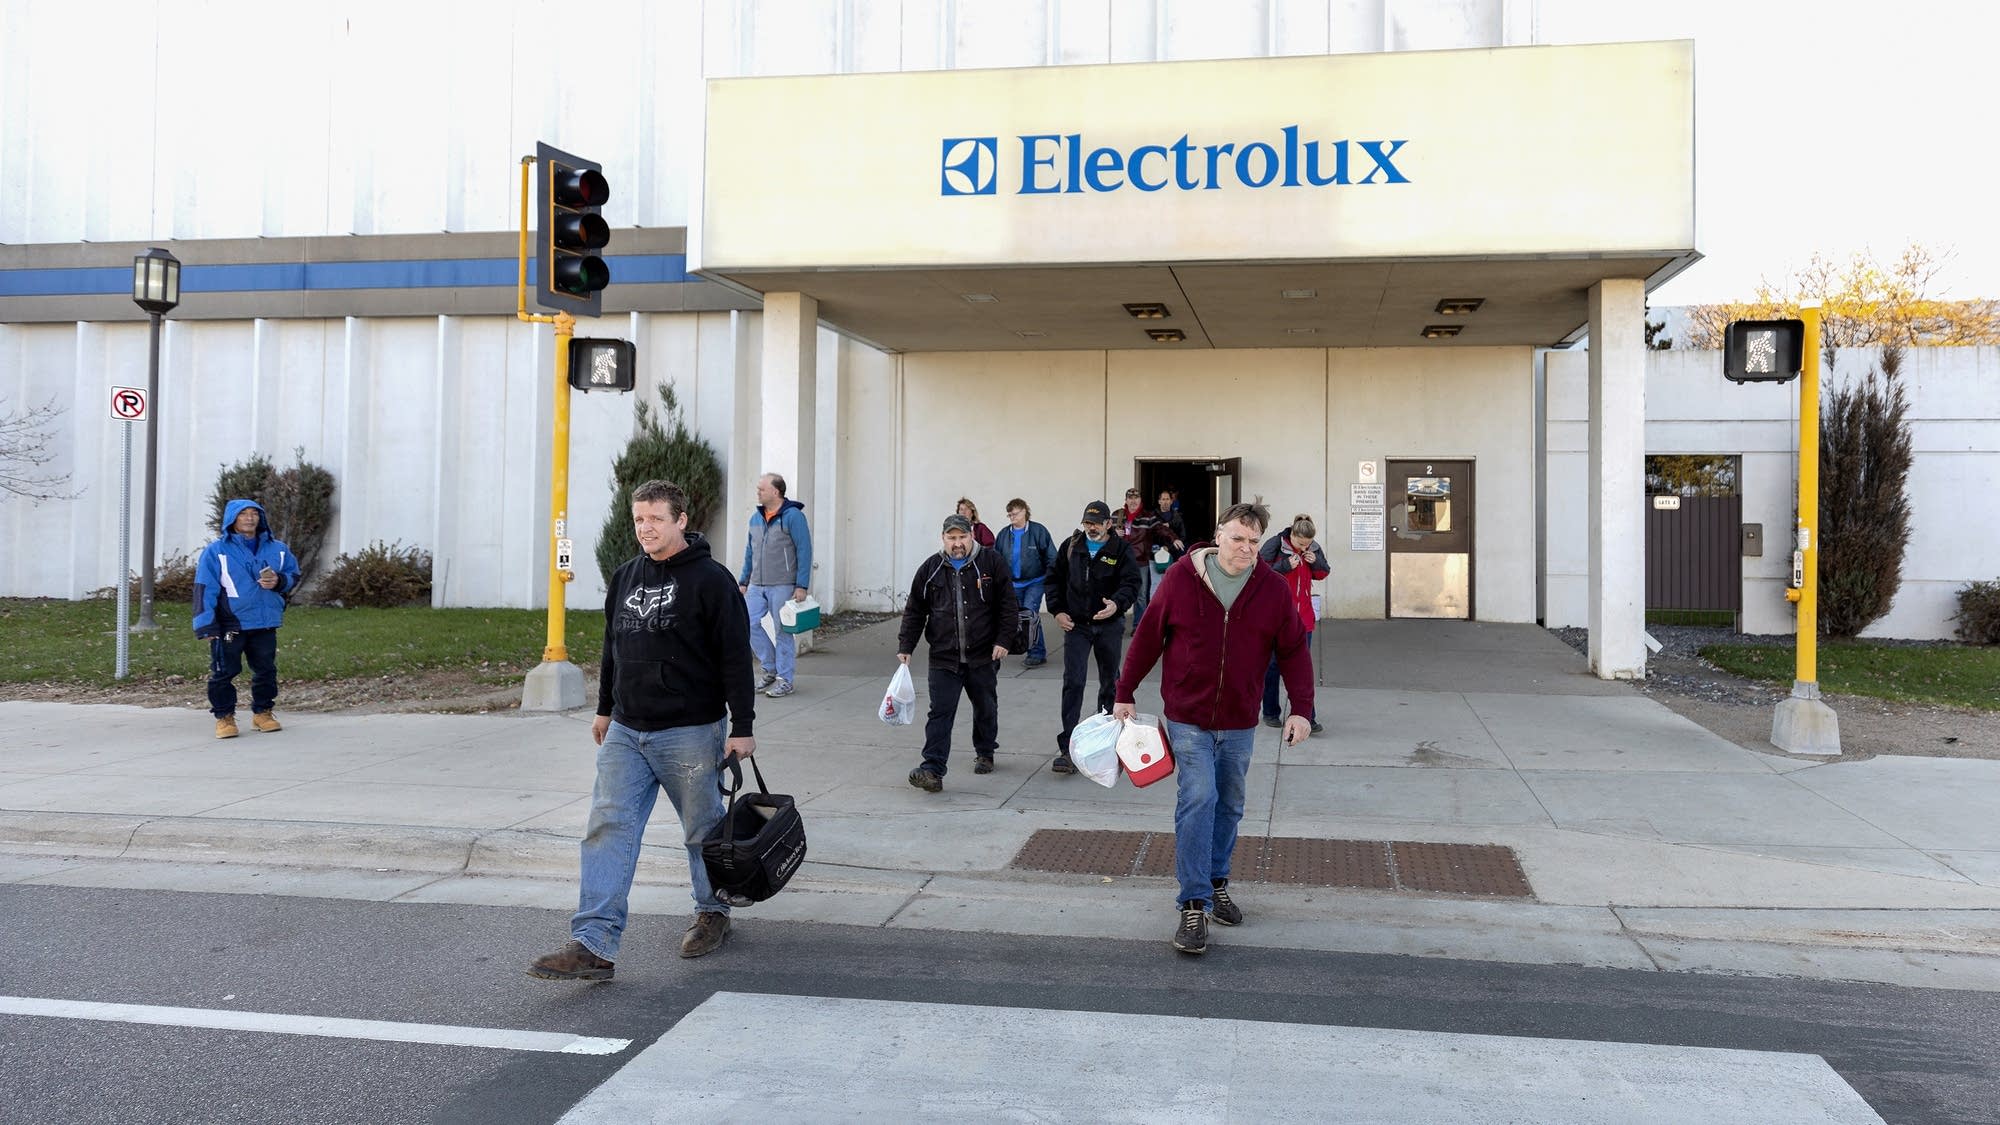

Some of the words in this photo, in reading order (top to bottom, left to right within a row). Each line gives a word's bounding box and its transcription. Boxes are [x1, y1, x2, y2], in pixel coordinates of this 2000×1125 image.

[1015, 125, 1412, 195] Electrolux
[123, 395, 138, 412] P
[1426, 465, 1433, 475] 2
